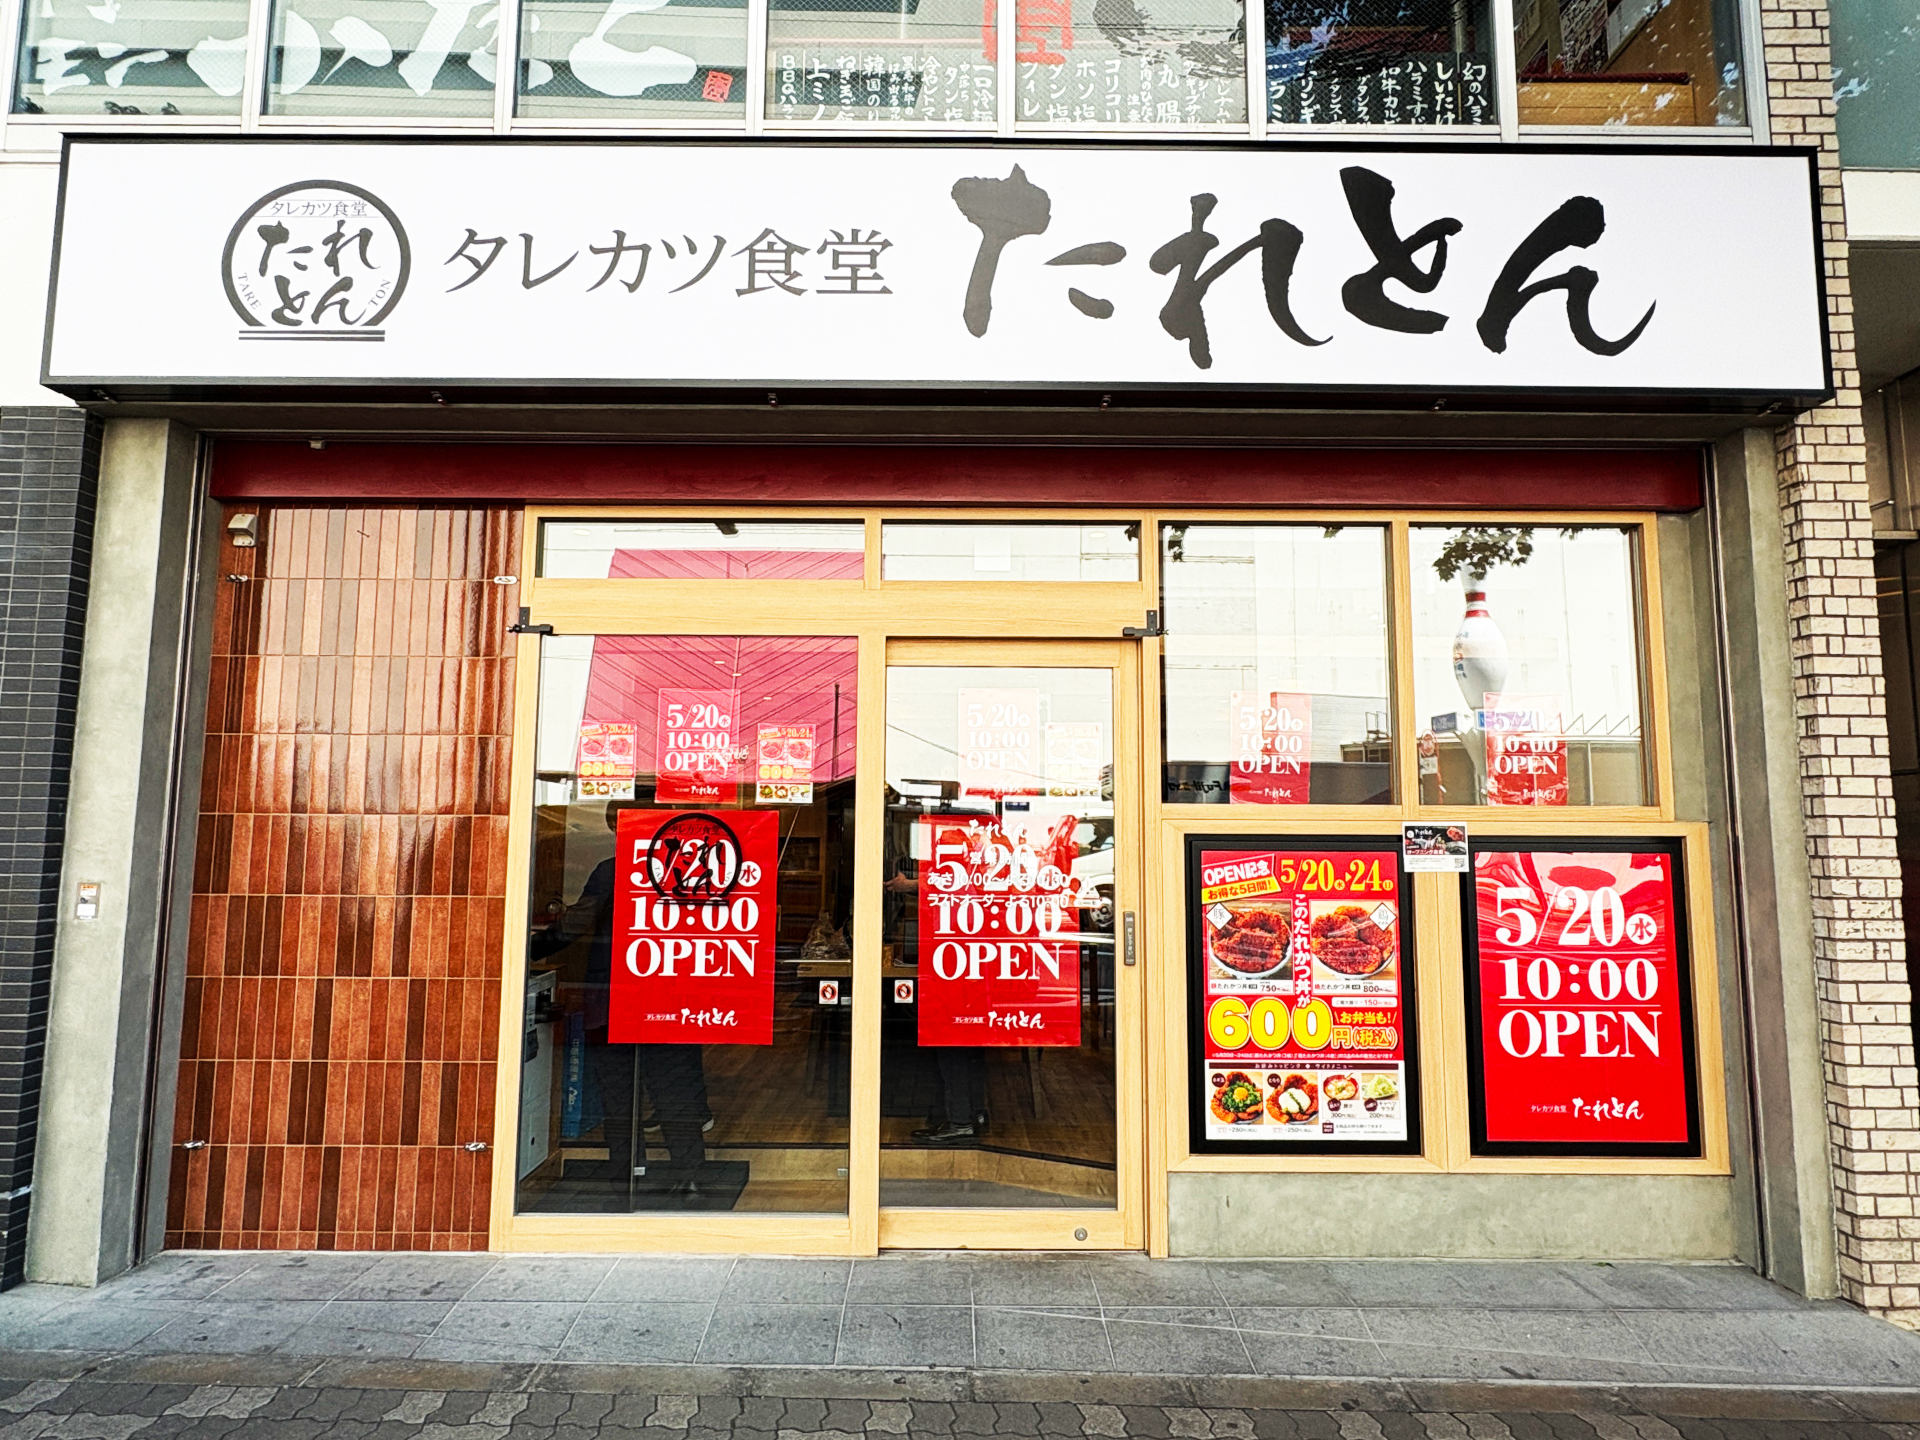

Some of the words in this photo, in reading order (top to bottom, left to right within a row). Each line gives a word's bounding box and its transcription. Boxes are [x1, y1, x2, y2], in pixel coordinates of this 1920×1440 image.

[806, 57, 831, 121] 上ミノ
[1434, 61, 1455, 125] しいたけ
[270, 200, 368, 216] タレカツ食堂
[257, 219, 381, 277] たれ
[443, 227, 894, 298] タレカツ食堂
[951, 162, 1656, 369] たれとん
[238, 272, 262, 310] TARE
[271, 275, 367, 326] とん
[367, 278, 392, 308] TON
[666, 731, 730, 749] 10:00
[968, 730, 1031, 748] 10:00
[1240, 734, 1303, 753] 10:00
[664, 751, 732, 772] OPEN
[966, 750, 1031, 770] OPEN
[1238, 754, 1301, 774] OPEN
[1494, 755, 1558, 775] OPEN
[1203, 859, 1271, 886] OPEN記念
[629, 896, 760, 932] 10:00
[934, 901, 1063, 935] 10:00
[625, 937, 760, 978] OPEN
[932, 941, 1064, 981] OPEN
[1294, 893, 1311, 1009] このたれかつ丼が
[1498, 957, 1659, 1001] 10:00
[681, 1008, 738, 1027] たれとん
[988, 1010, 1045, 1031] たれとん
[1208, 996, 1334, 1050] 600
[1499, 1009, 1663, 1058] OPEN
[1572, 1097, 1645, 1121] たれとん
